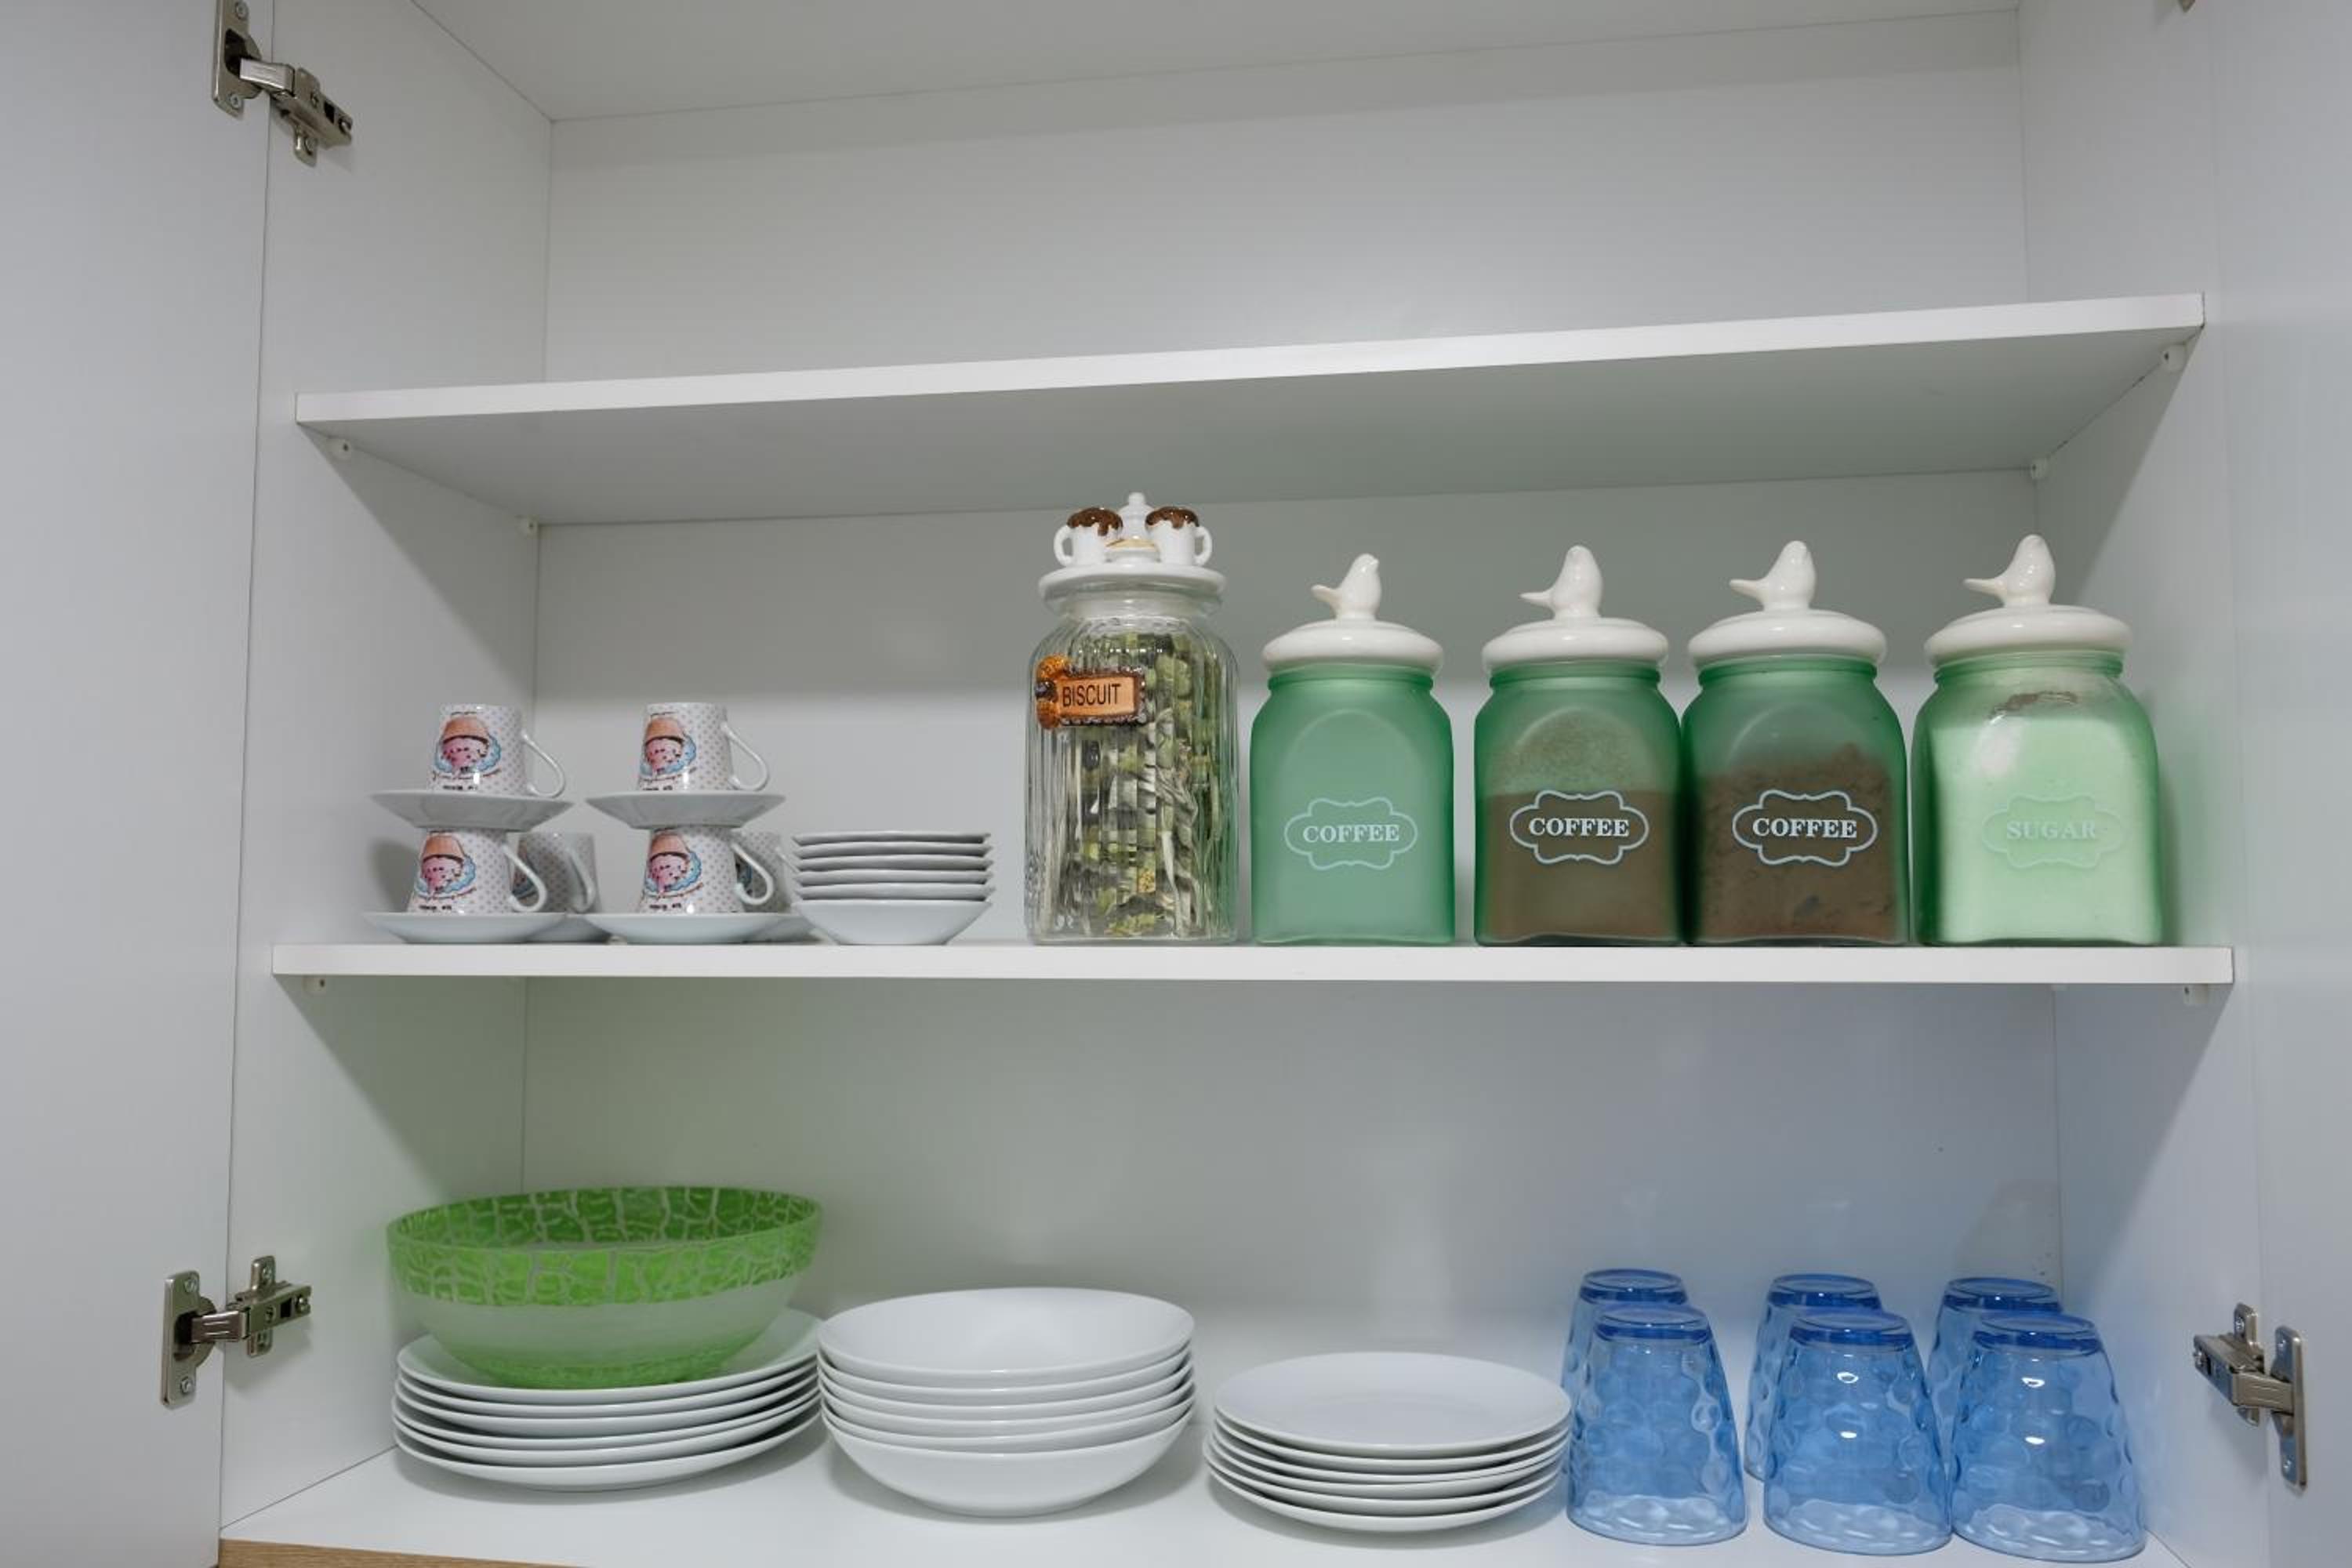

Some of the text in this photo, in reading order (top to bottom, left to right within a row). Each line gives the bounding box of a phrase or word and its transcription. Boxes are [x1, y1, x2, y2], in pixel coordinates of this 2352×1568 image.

[1062, 683, 1122, 707] BISCUIT
[1302, 824, 1400, 844] COFFEE
[1529, 817, 1630, 837] COFFEE
[1752, 818, 1857, 838] COFFEE
[2006, 821, 2098, 840] SUGAR
